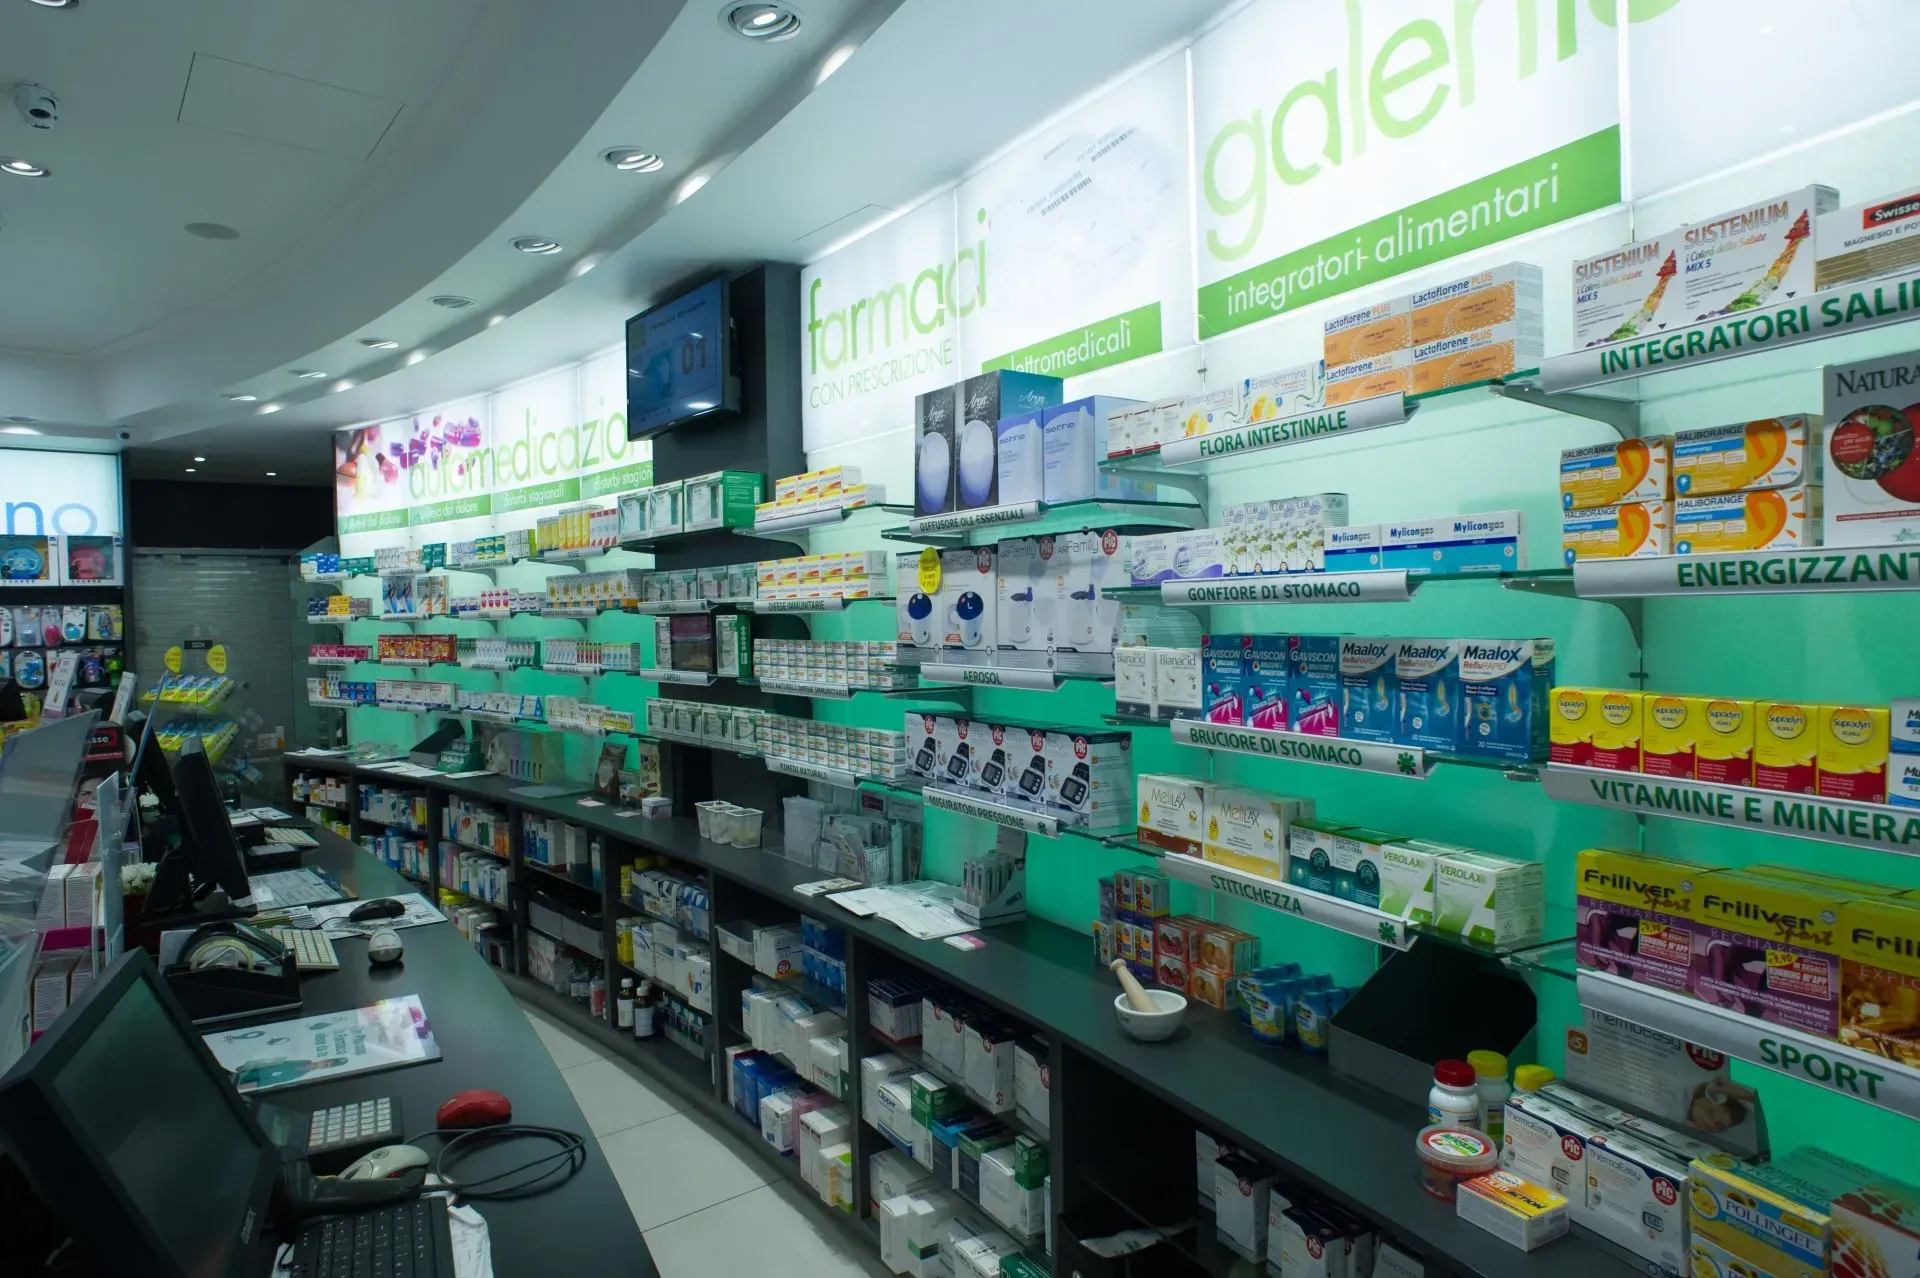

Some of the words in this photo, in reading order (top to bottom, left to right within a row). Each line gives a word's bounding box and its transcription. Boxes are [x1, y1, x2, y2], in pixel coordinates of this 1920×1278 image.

[1874, 201, 1920, 221] Swisse
[1684, 200, 1788, 247] SUSTENIUM
[1227, 237, 1362, 320] integratori
[1375, 163, 1559, 264] alimentari
[1844, 229, 1893, 248] MAGNESIO
[1895, 226, 1902, 234] E
[1576, 242, 1659, 280] SUSTENIUM
[1685, 262, 1703, 274] MIX
[1705, 259, 1711, 269] 5
[808, 207, 987, 375] farmaci
[1412, 280, 1469, 304] Lactoflorene
[1471, 272, 1493, 286] PLUS
[1577, 294, 1591, 304] MIX
[1593, 291, 1598, 299] 5
[1324, 309, 1371, 332] Lactoflorene
[1372, 303, 1391, 316] PLUS
[1414, 335, 1468, 359] Lactoflorene
[1470, 330, 1493, 345] PLUS
[1600, 304, 1811, 375] INTEGRATORI
[810, 379, 844, 409] CON
[848, 338, 953, 400] PRESCRIZIONE
[1326, 360, 1373, 381] Lactoflorene
[1374, 355, 1393, 369] PLUS
[1200, 431, 1245, 457] FLORA
[1249, 410, 1348, 449] INTESTINALE
[1676, 425, 1743, 442] HALIBORANGE
[1562, 444, 1616, 459] HALIBORANGE
[1677, 495, 1744, 508] HALIBORANGE
[920, 517, 960, 532] DIFFUSORE
[961, 516, 974, 526] OLI
[976, 509, 1025, 525] ESSENZIALI
[1565, 507, 1617, 519] HALIBORANGE
[1390, 526, 1434, 539] Mylicongas
[1454, 520, 1505, 534] Mylicongas
[1331, 532, 1371, 543] Mylicongas
[1187, 585, 1260, 602] GONFIORE
[1264, 584, 1279, 599] DI
[1284, 581, 1360, 600] STOMACO
[1160, 653, 1196, 667] Bianacid
[1203, 648, 1241, 658] GAVISCON
[1244, 649, 1286, 660] GAVISCON
[1291, 650, 1337, 663] GAVISCON
[1342, 642, 1389, 659] Maalox
[1399, 644, 1450, 661] Maalox
[1463, 645, 1522, 663] Maalox
[1463, 660, 1508, 671] RefluRAPID
[963, 670, 1002, 685] AEROSOL
[1708, 709, 1740, 719] Supradyn
[1768, 714, 1804, 724] Supradyn
[1833, 719, 1871, 730] Supradyn
[1190, 728, 1260, 753] BRUCIORE
[1263, 737, 1278, 755] DI
[1279, 738, 1363, 767] STOMACO
[1590, 778, 1735, 819] VITAMINE
[1745, 797, 1763, 823] E
[929, 794, 976, 819] MISURATORI
[977, 807, 1025, 830] PRESSIONE
[1384, 851, 1421, 869] VEROLAX
[1440, 864, 1482, 884] VEROLAX
[1584, 869, 1676, 898] Friliver
[1211, 874, 1304, 916] STITICHEZZA
[1642, 887, 1691, 912] Sport
[1590, 899, 1677, 927] RECHARGE
[1703, 894, 1814, 929] Friliver
[1774, 917, 1834, 946] Sport
[1758, 1037, 1884, 1100] SPORT
[1564, 1138, 1580, 1155] PiC
[1655, 1180, 1673, 1200] PiC
[1505, 1191, 1546, 1210] ACTION
[1725, 1199, 1816, 1252] POLLINGEL
